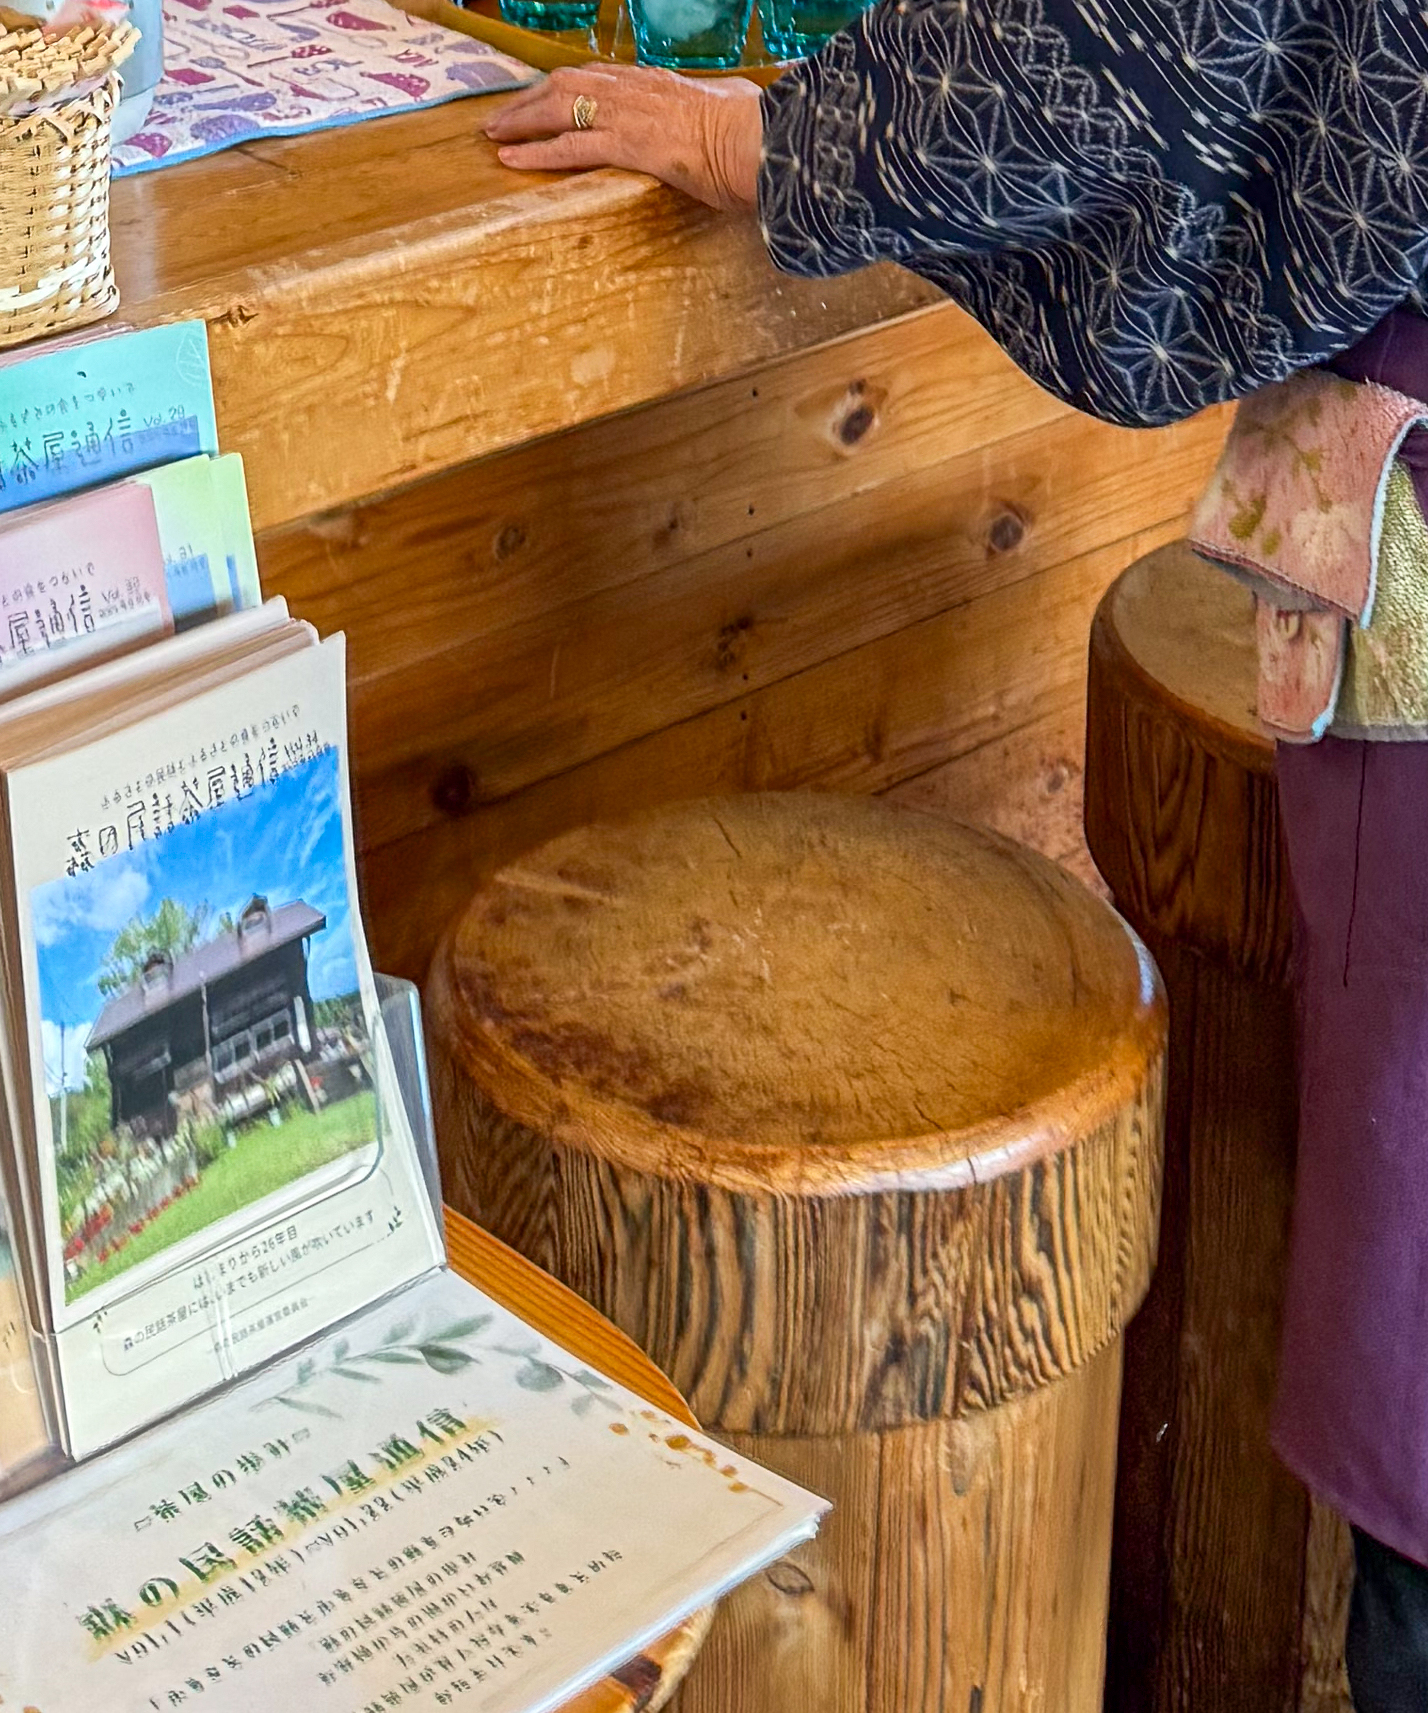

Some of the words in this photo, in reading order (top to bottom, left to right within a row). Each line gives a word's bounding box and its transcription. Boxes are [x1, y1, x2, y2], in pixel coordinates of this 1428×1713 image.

[65, 736, 280, 878] 森の民話茶屋通信
[78, 1406, 468, 1643] 森の民話茶屋通信
